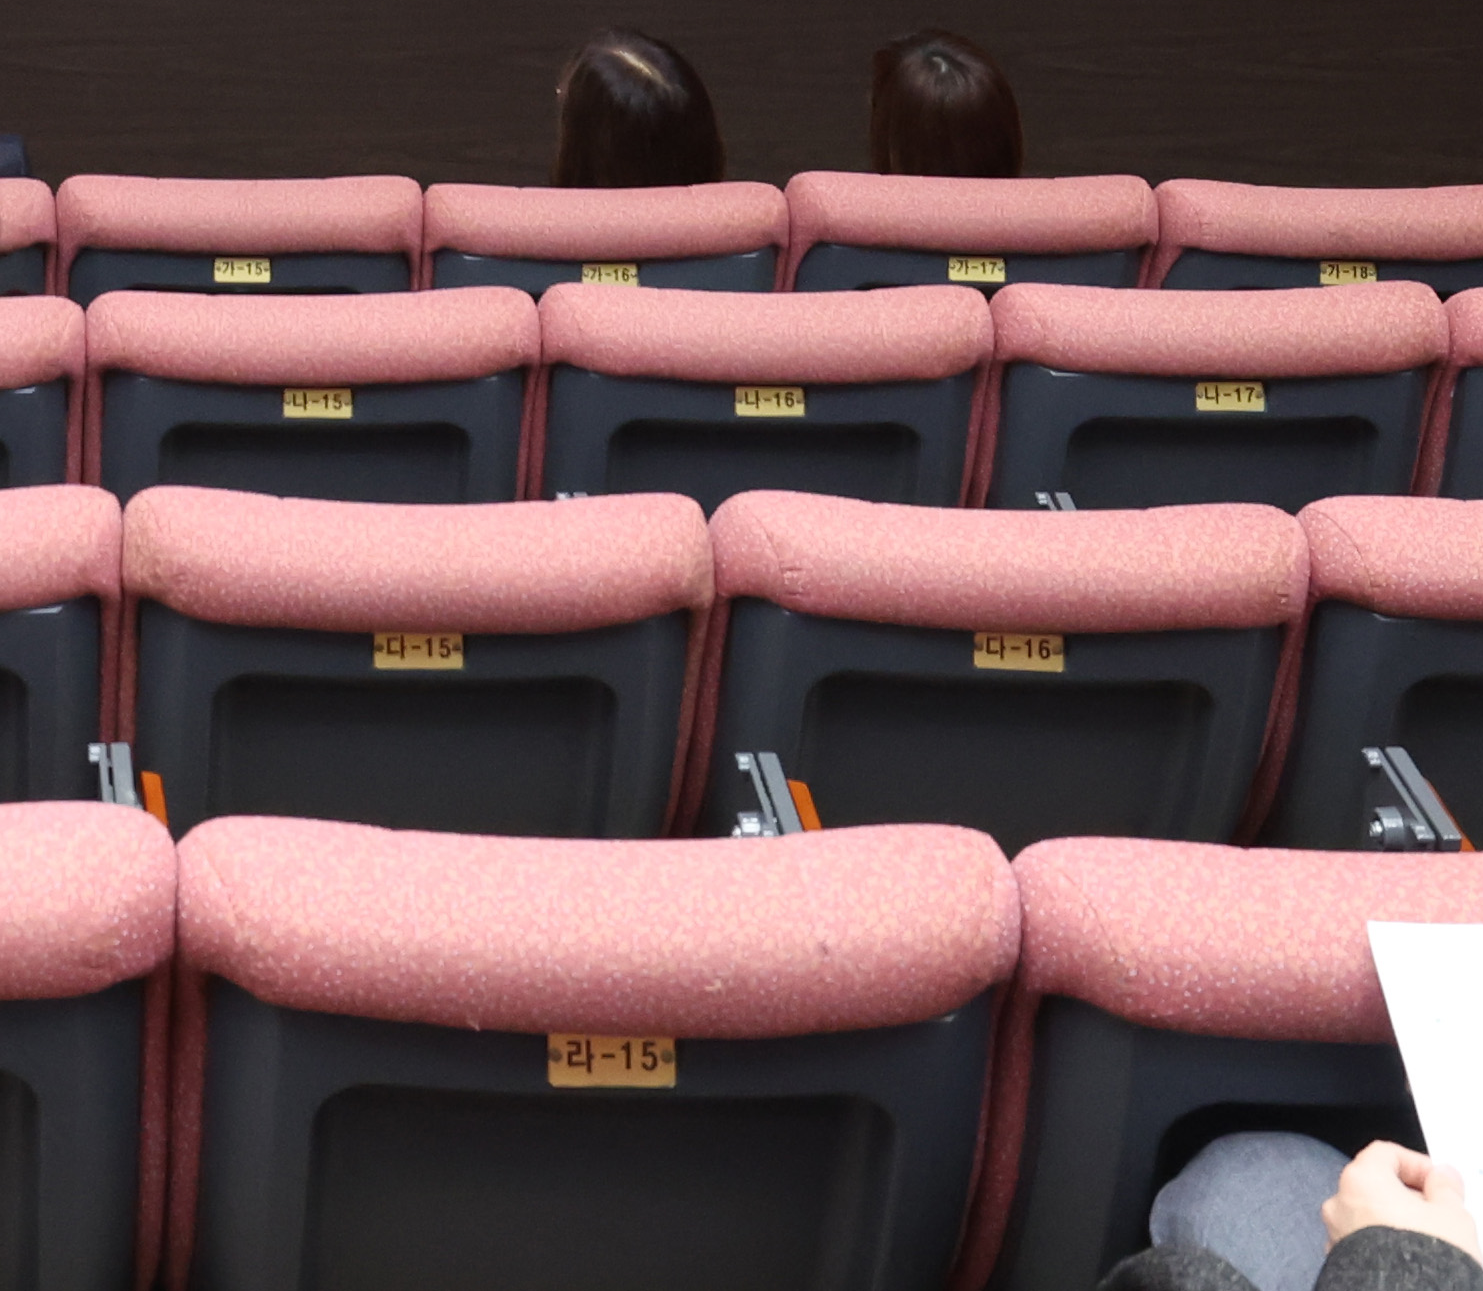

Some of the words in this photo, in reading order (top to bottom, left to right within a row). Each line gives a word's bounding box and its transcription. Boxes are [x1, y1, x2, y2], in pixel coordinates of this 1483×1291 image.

[221, 261, 263, 276] 가-15
[590, 268, 629, 282] 가-16
[957, 261, 995, 275] 가-17
[1327, 265, 1367, 278] 가-18
[293, 391, 342, 410] 나-15
[744, 389, 795, 408] 나-16
[1205, 384, 1254, 403] 나-17
[386, 633, 452, 658] 다-15
[984, 635, 1051, 659] 다-16
[566, 1039, 659, 1074] 라-15
